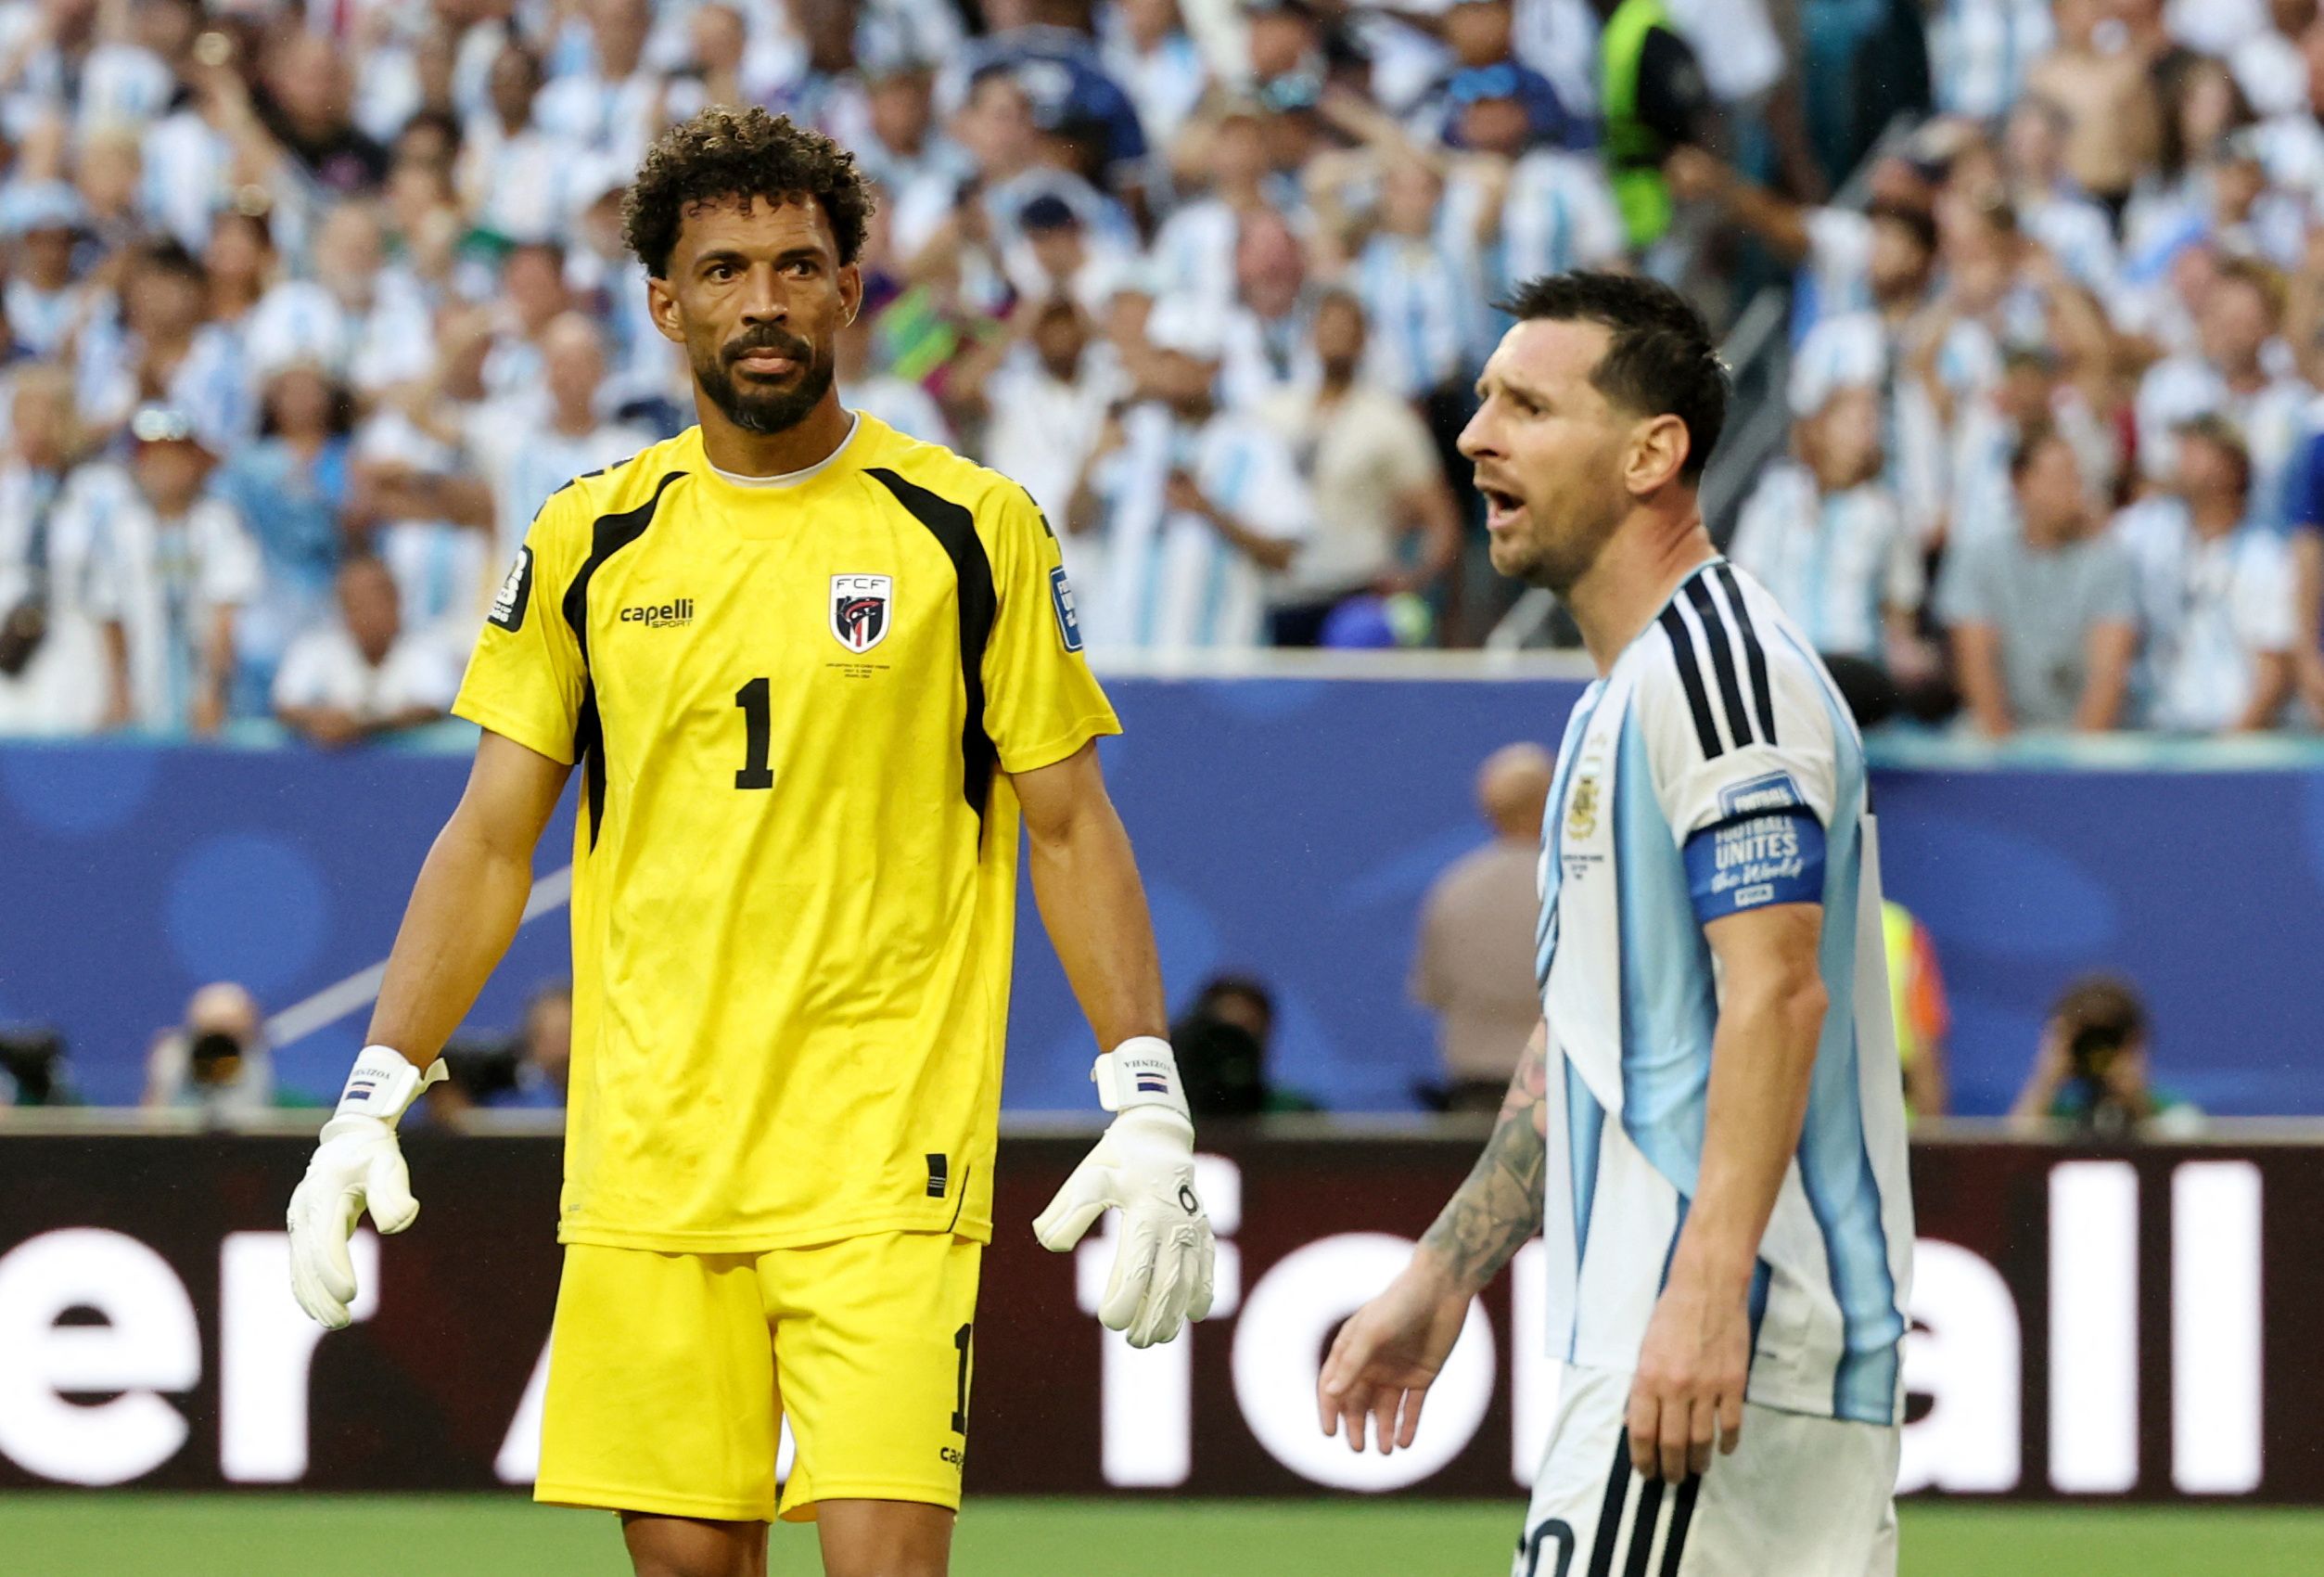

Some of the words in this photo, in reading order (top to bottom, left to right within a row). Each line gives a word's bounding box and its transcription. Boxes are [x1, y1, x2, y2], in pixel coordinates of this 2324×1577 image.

[836, 578, 887, 590] FCF
[619, 598, 694, 627] capelli
[651, 619, 693, 629] SPORT
[734, 677, 773, 789] 1
[1715, 832, 1798, 871] UNITES
[0, 1225, 381, 1484] er
[951, 1323, 971, 1436] 1
